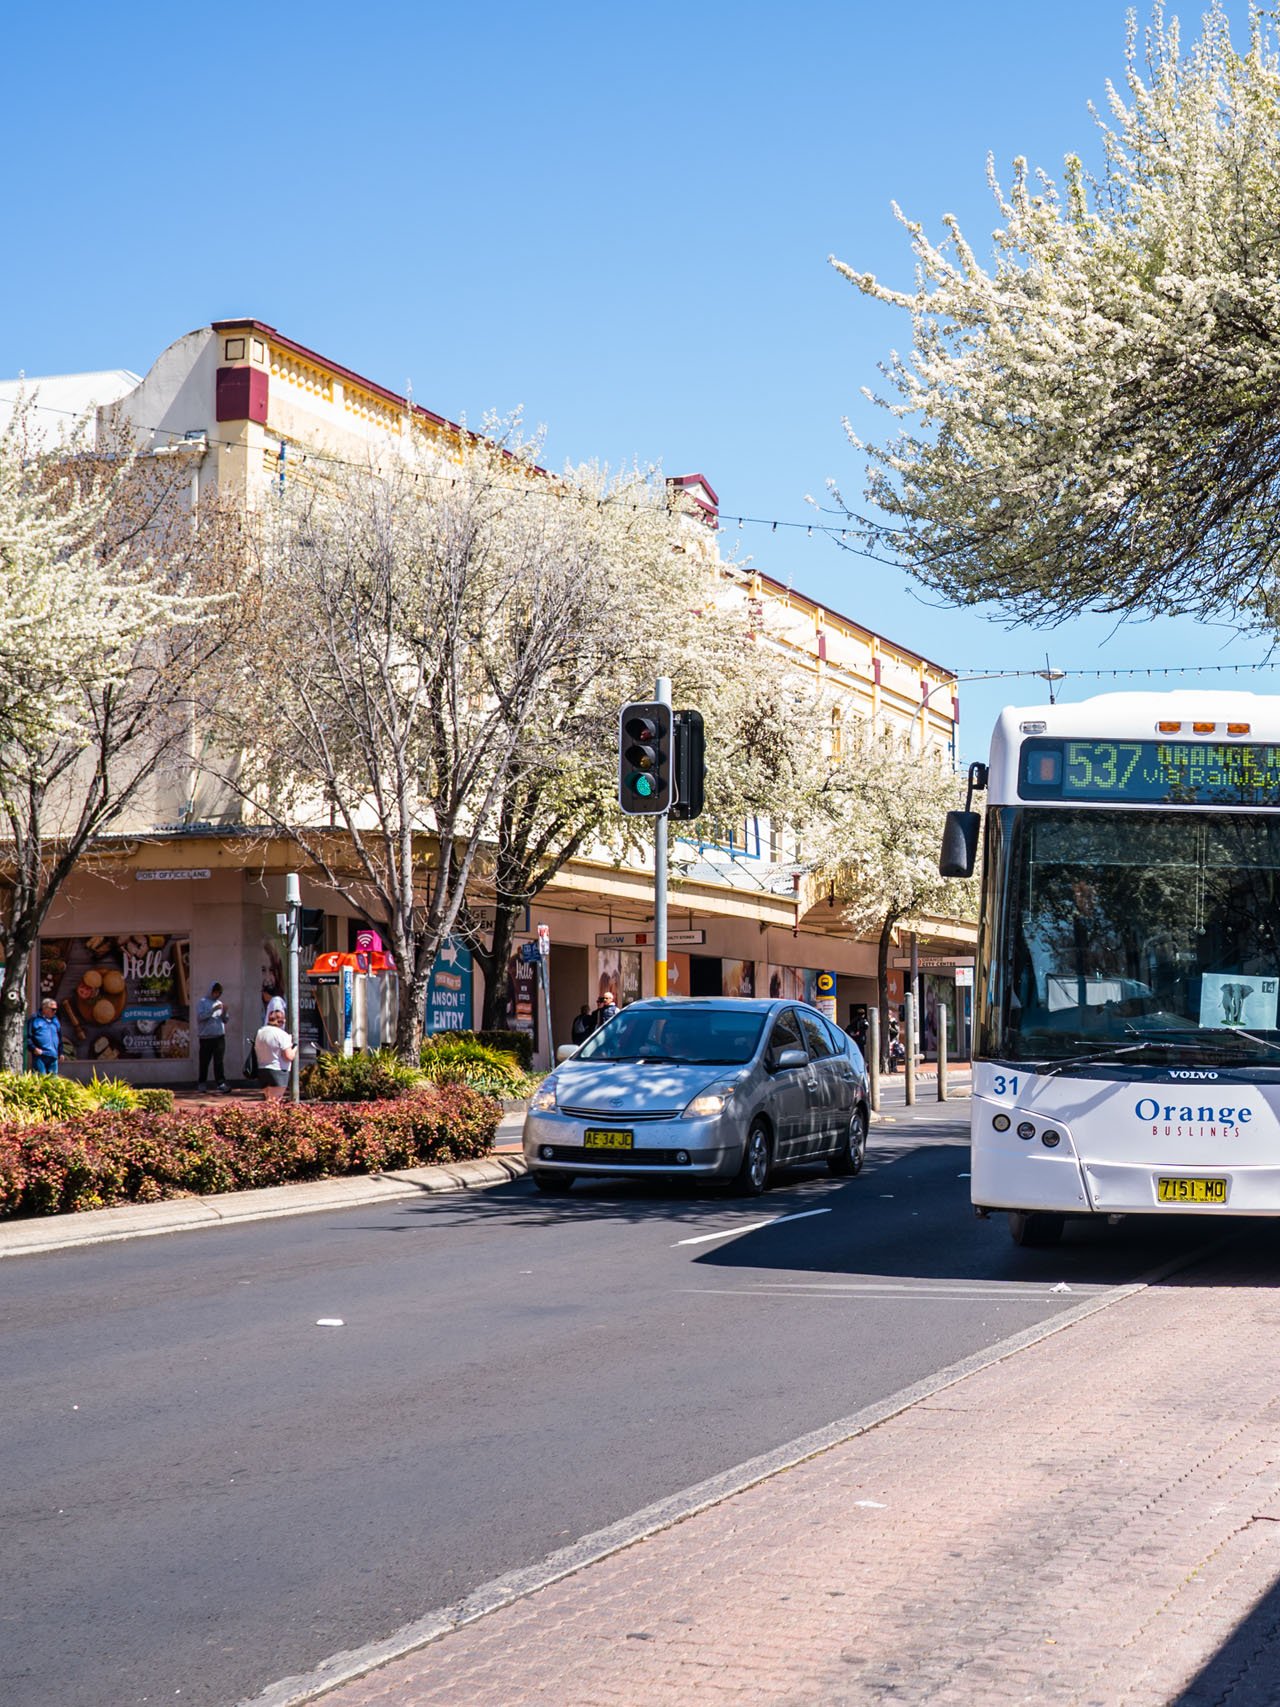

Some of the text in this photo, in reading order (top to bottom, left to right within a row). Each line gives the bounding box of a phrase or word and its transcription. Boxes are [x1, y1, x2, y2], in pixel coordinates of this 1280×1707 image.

[1069, 743, 1142, 788] 537
[1157, 745, 1257, 767] ORANGE
[1144, 769, 1180, 784] via
[1190, 768, 1279, 789] Railway
[159, 871, 186, 879] OFFICE
[187, 870, 208, 878] LANE
[121, 950, 175, 980] Hello
[1263, 982, 1274, 992] 14
[432, 991, 458, 1007] ANSON
[124, 1008, 170, 1019] OPENING HERE
[433, 1010, 464, 1030] ENTRY
[1168, 1070, 1218, 1079] VOLVO
[994, 1076, 1018, 1095] 31
[1135, 1098, 1252, 1128] Orange
[1152, 1126, 1240, 1138] BUSLINES
